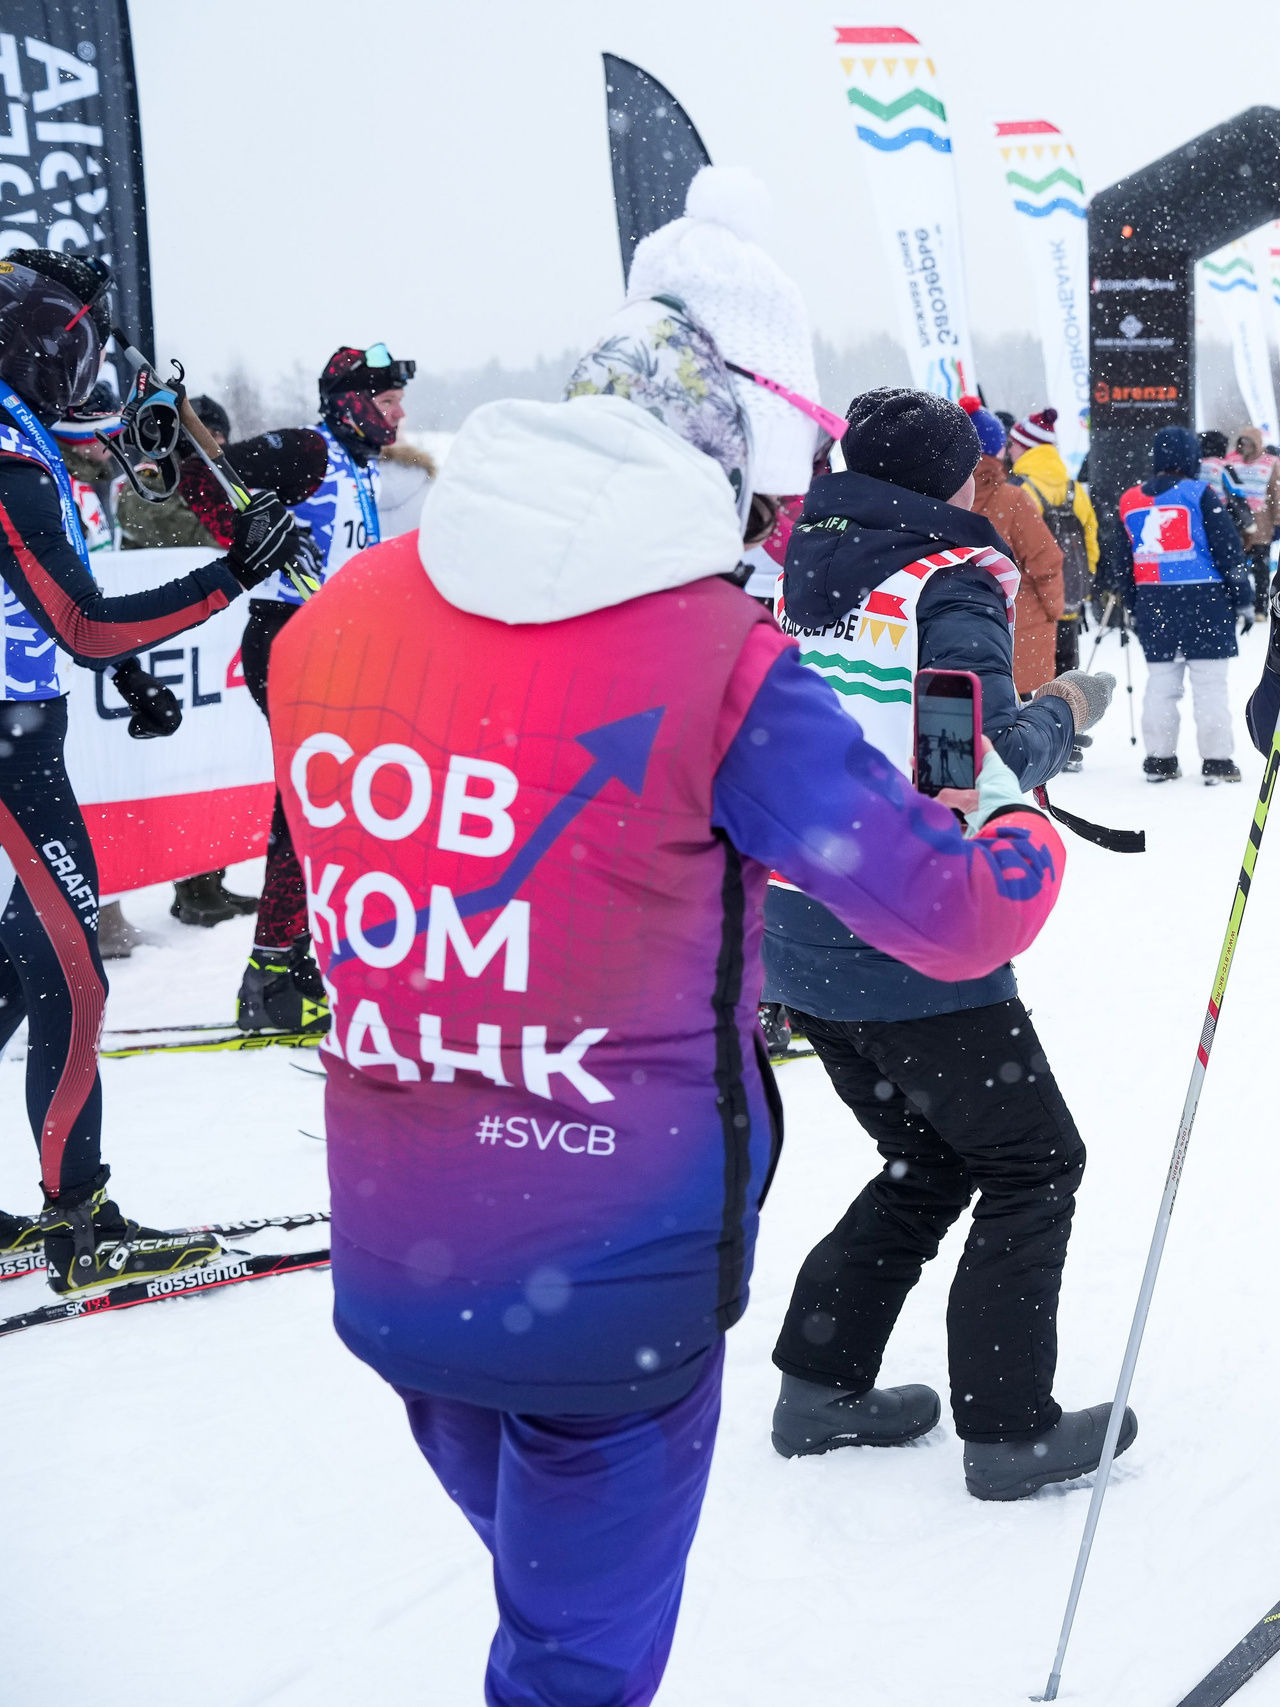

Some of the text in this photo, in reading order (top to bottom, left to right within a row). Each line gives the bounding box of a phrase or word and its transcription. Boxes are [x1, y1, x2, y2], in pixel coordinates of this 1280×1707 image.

[1111, 386, 1178, 400] arenza
[290, 732, 519, 858] СОВ
[42, 838, 98, 911] CRAFT
[303, 855, 531, 993] КОМ
[1214, 930, 1236, 1004] WWW.STC-SKI.RU
[475, 1115, 616, 1156] #SVCB
[1180, 1127, 1188, 1147] 100%
[1171, 1149, 1182, 1181] CARBON
[97, 1233, 207, 1252] FSCHER
